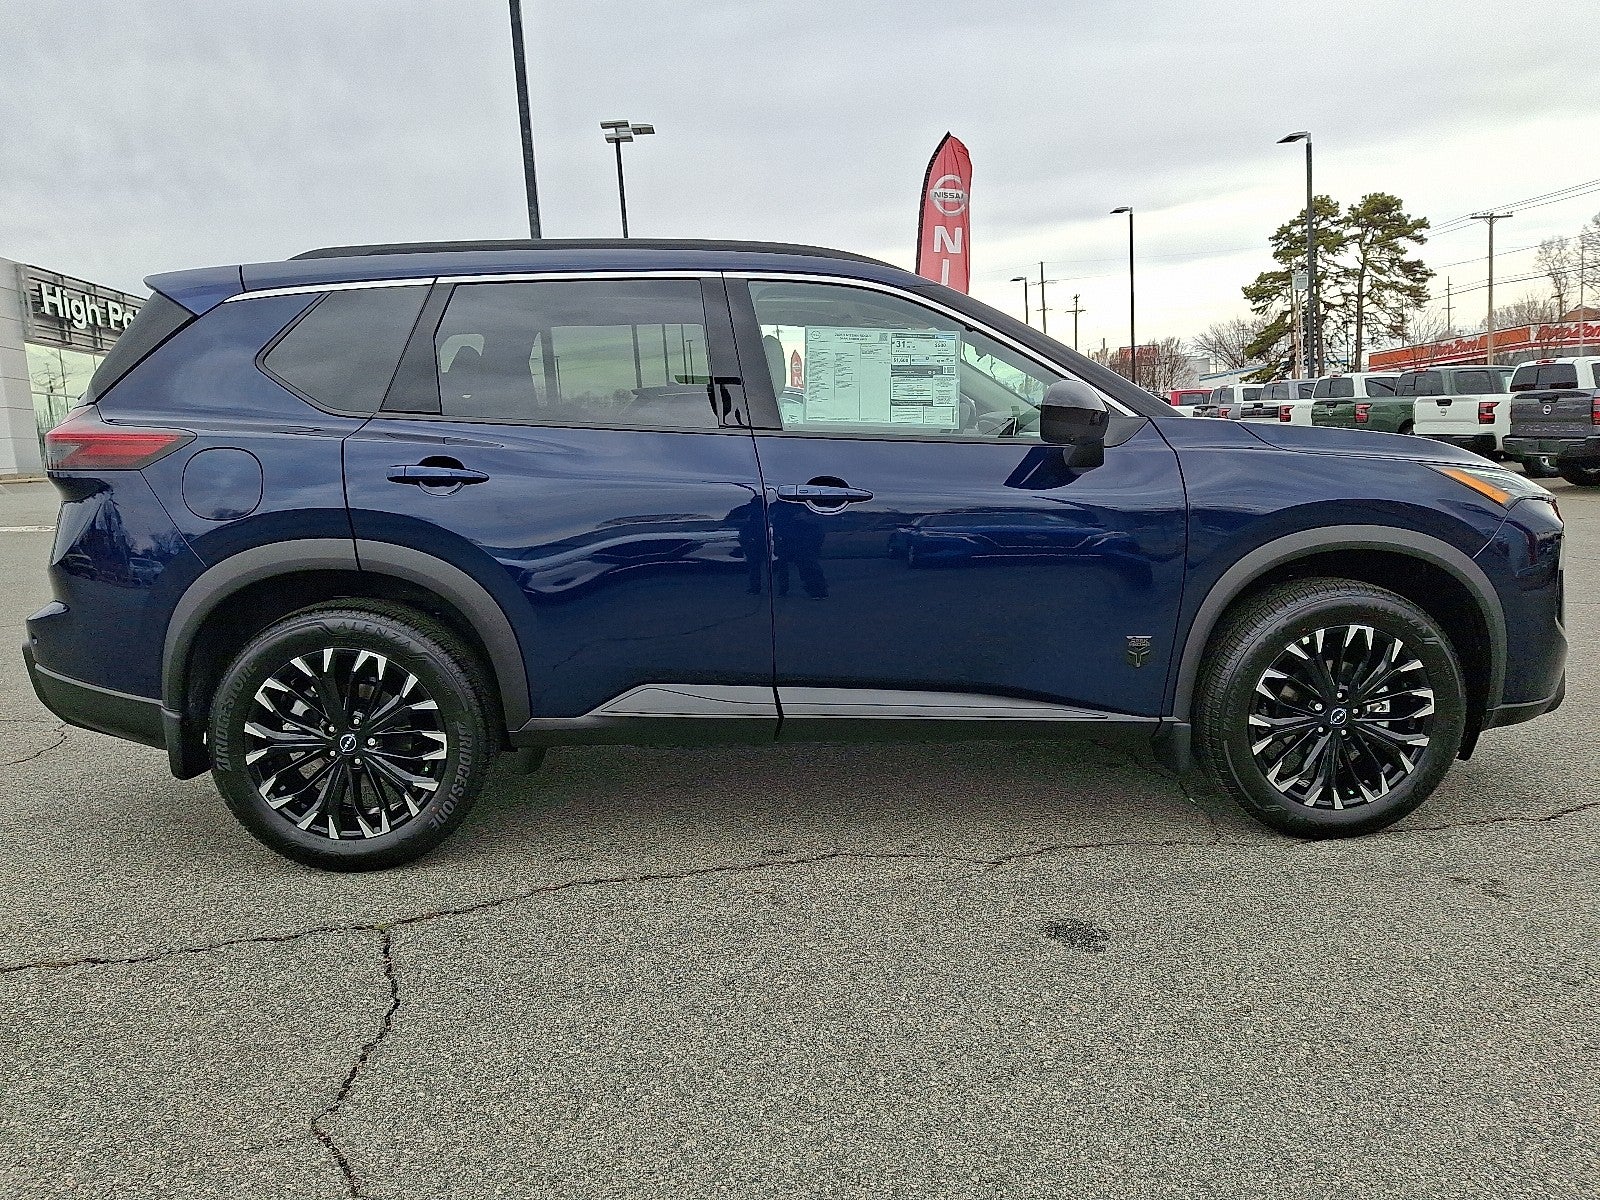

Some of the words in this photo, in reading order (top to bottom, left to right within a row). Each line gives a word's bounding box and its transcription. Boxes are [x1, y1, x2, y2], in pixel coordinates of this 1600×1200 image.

[40, 283, 101, 330] High
[107, 300, 139, 330] Po
[896, 340, 906, 348] 31
[337, 621, 412, 648] ALENZA
[215, 661, 257, 772] BRIDGESTONE
[428, 721, 473, 831] BRIDGESTONE
